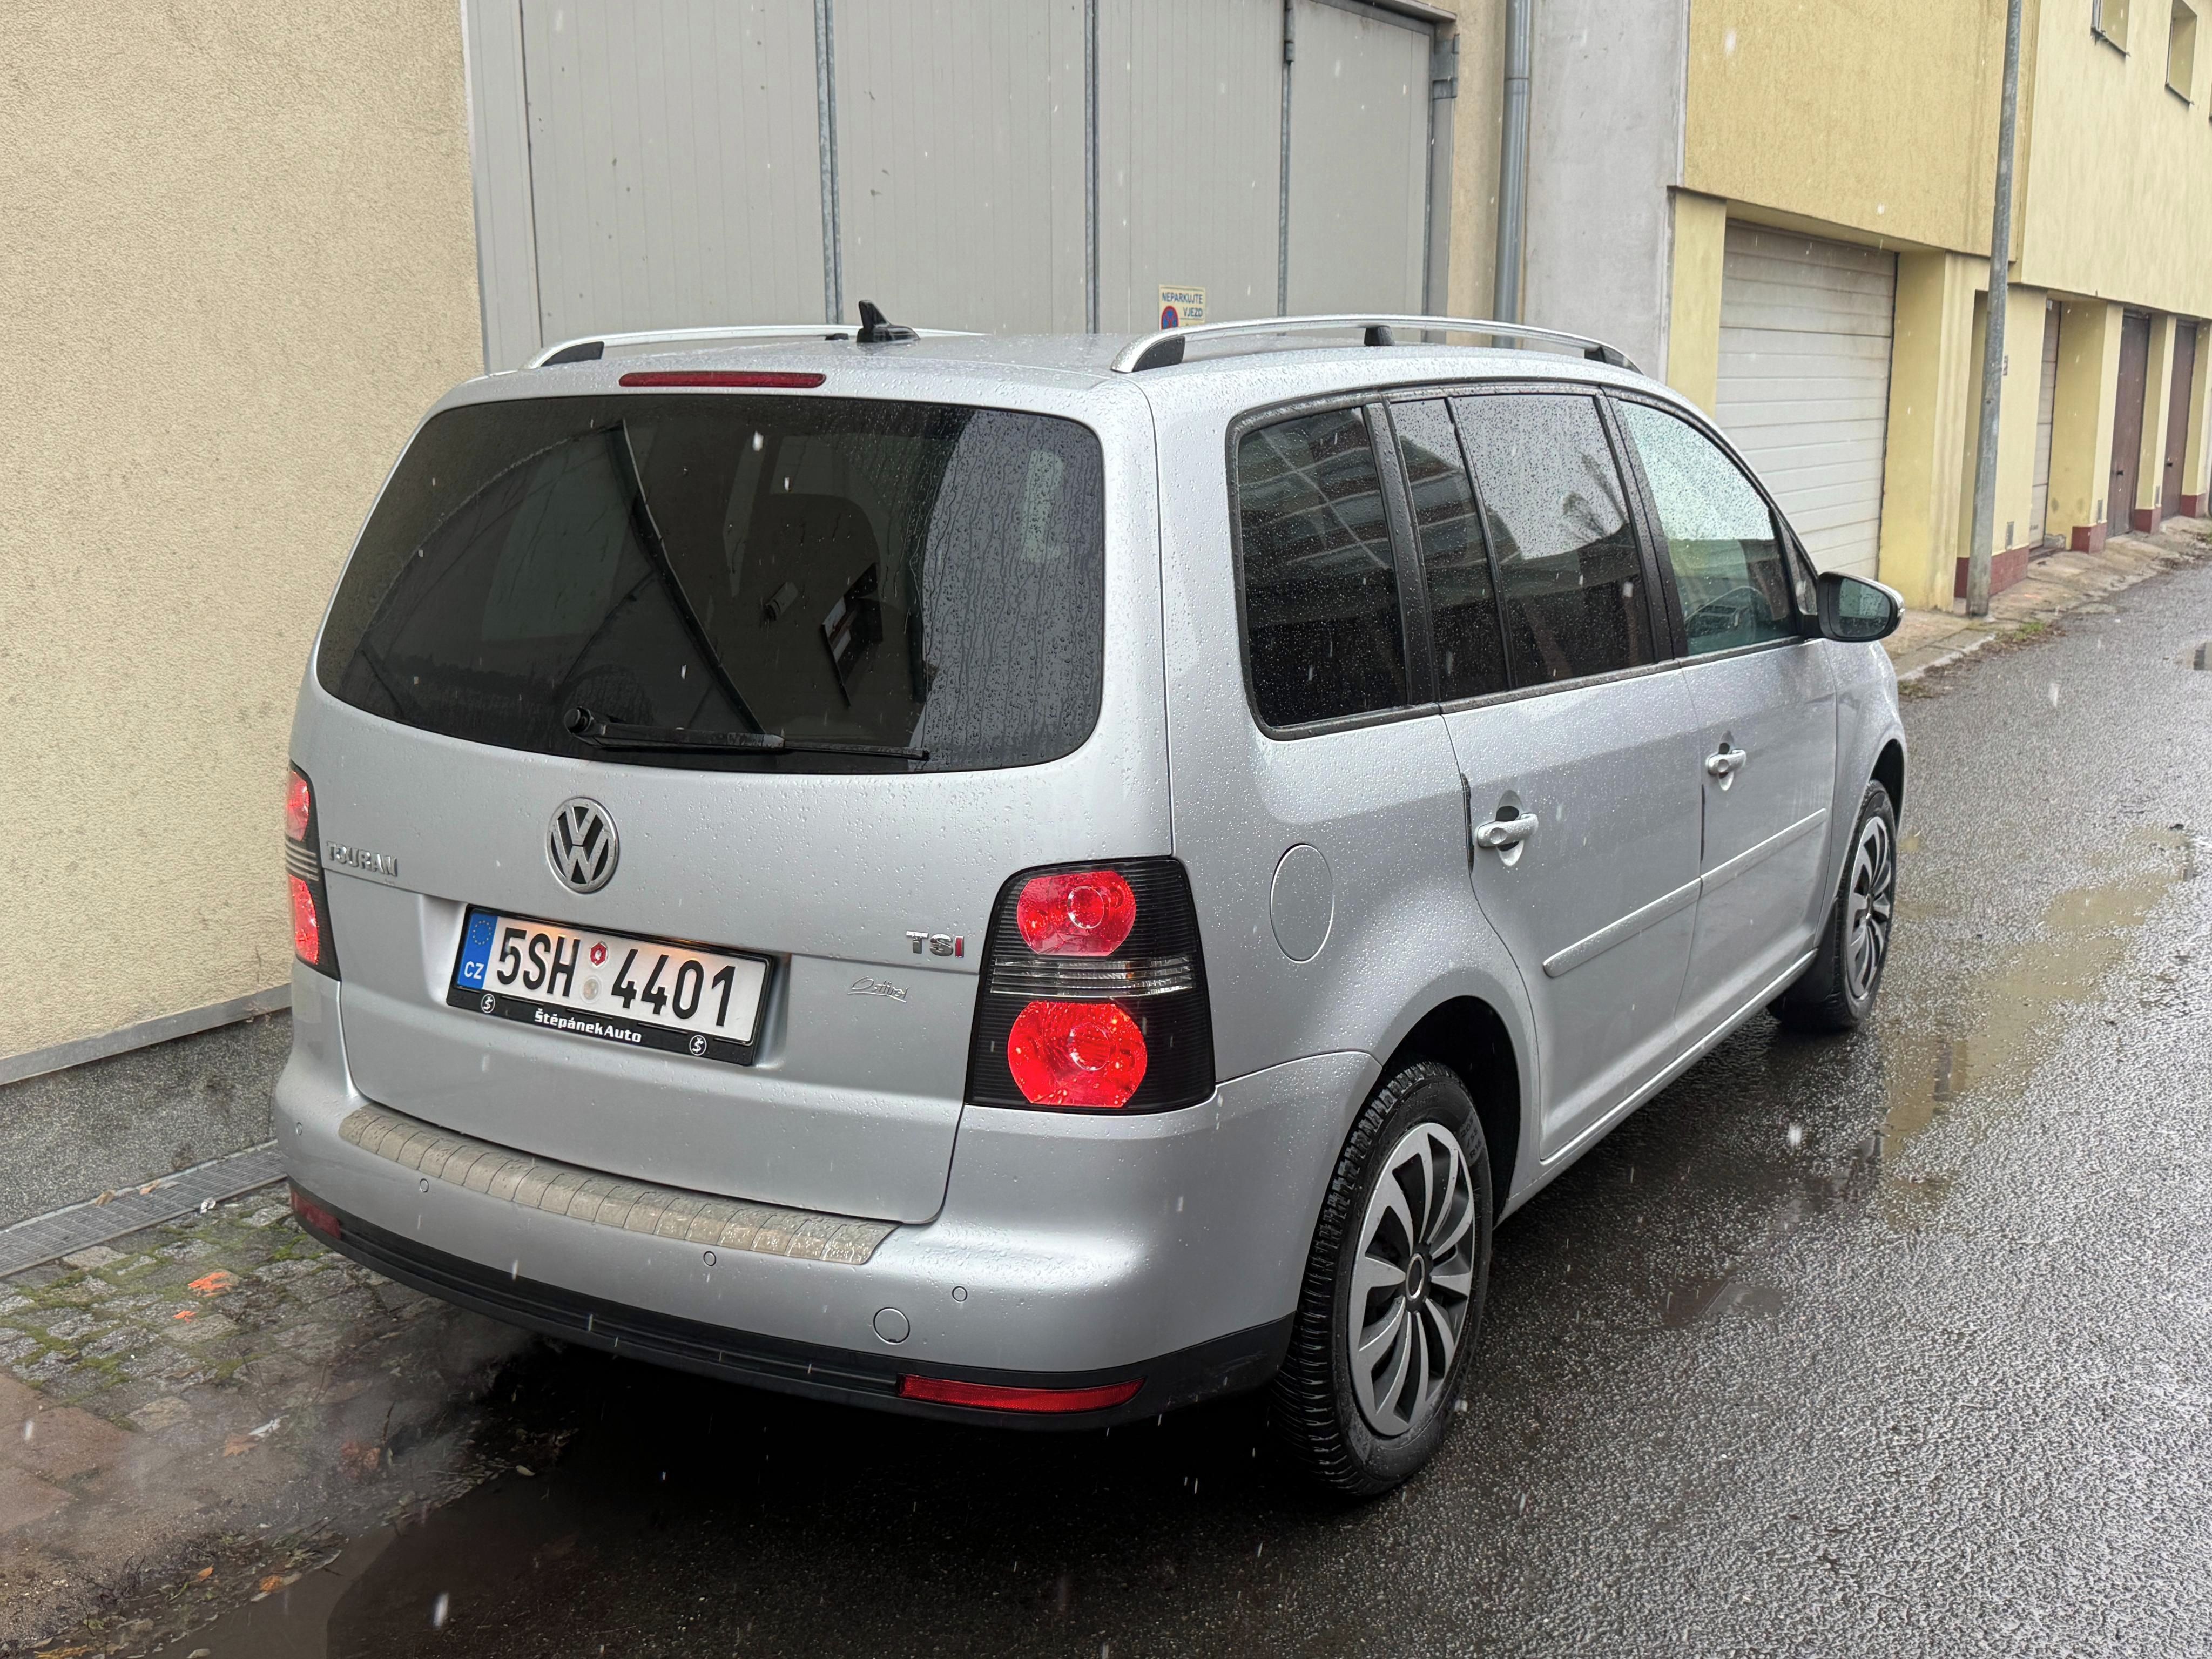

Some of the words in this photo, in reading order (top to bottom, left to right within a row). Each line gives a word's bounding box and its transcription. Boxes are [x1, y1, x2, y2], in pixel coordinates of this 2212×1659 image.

[1162, 292, 1203, 304] NEPARKUJTE
[1183, 307, 1203, 318] VJEZD
[326, 841, 398, 878] TOURAN
[464, 961, 484, 980] CZ
[497, 927, 581, 997] 5SH
[611, 948, 736, 1027] 4401
[535, 1008, 642, 1043] ŠtěpánekAuto
